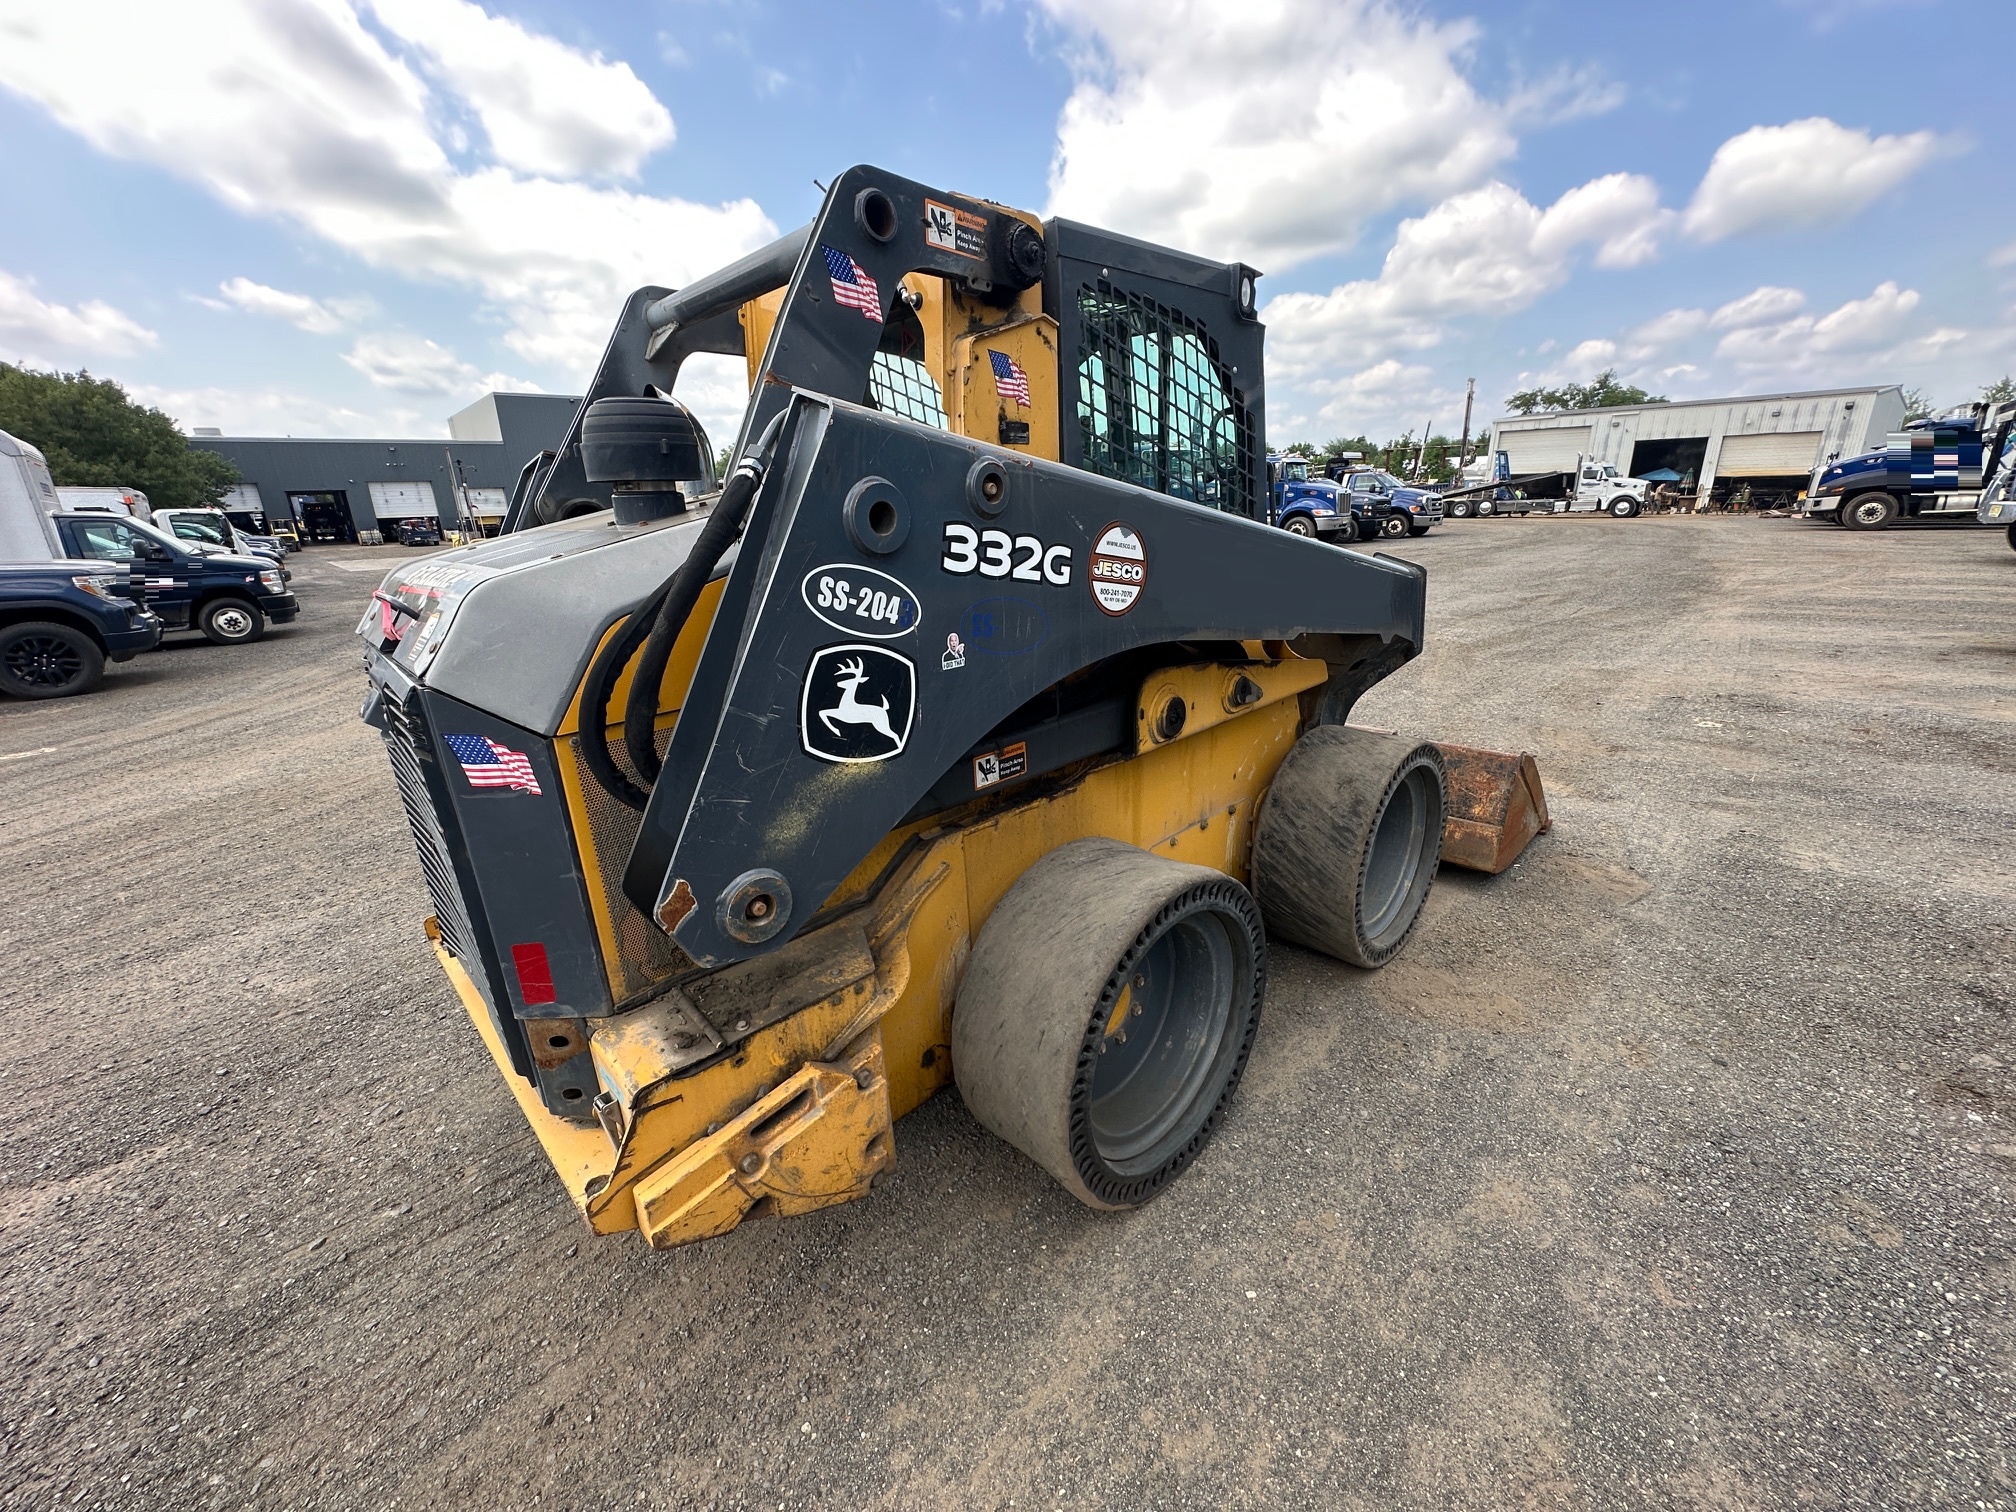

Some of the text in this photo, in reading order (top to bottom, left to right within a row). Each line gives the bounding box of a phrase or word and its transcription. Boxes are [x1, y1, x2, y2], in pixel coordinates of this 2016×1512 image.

[956, 229, 972, 241] Pinch
[956, 239, 981, 253] Keep Away
[942, 522, 1072, 586] 332G
[1093, 559, 1143, 582] JESCO
[1099, 587, 1133, 598] 800-241-7070
[1000, 757, 1024, 769] Pinch Area
